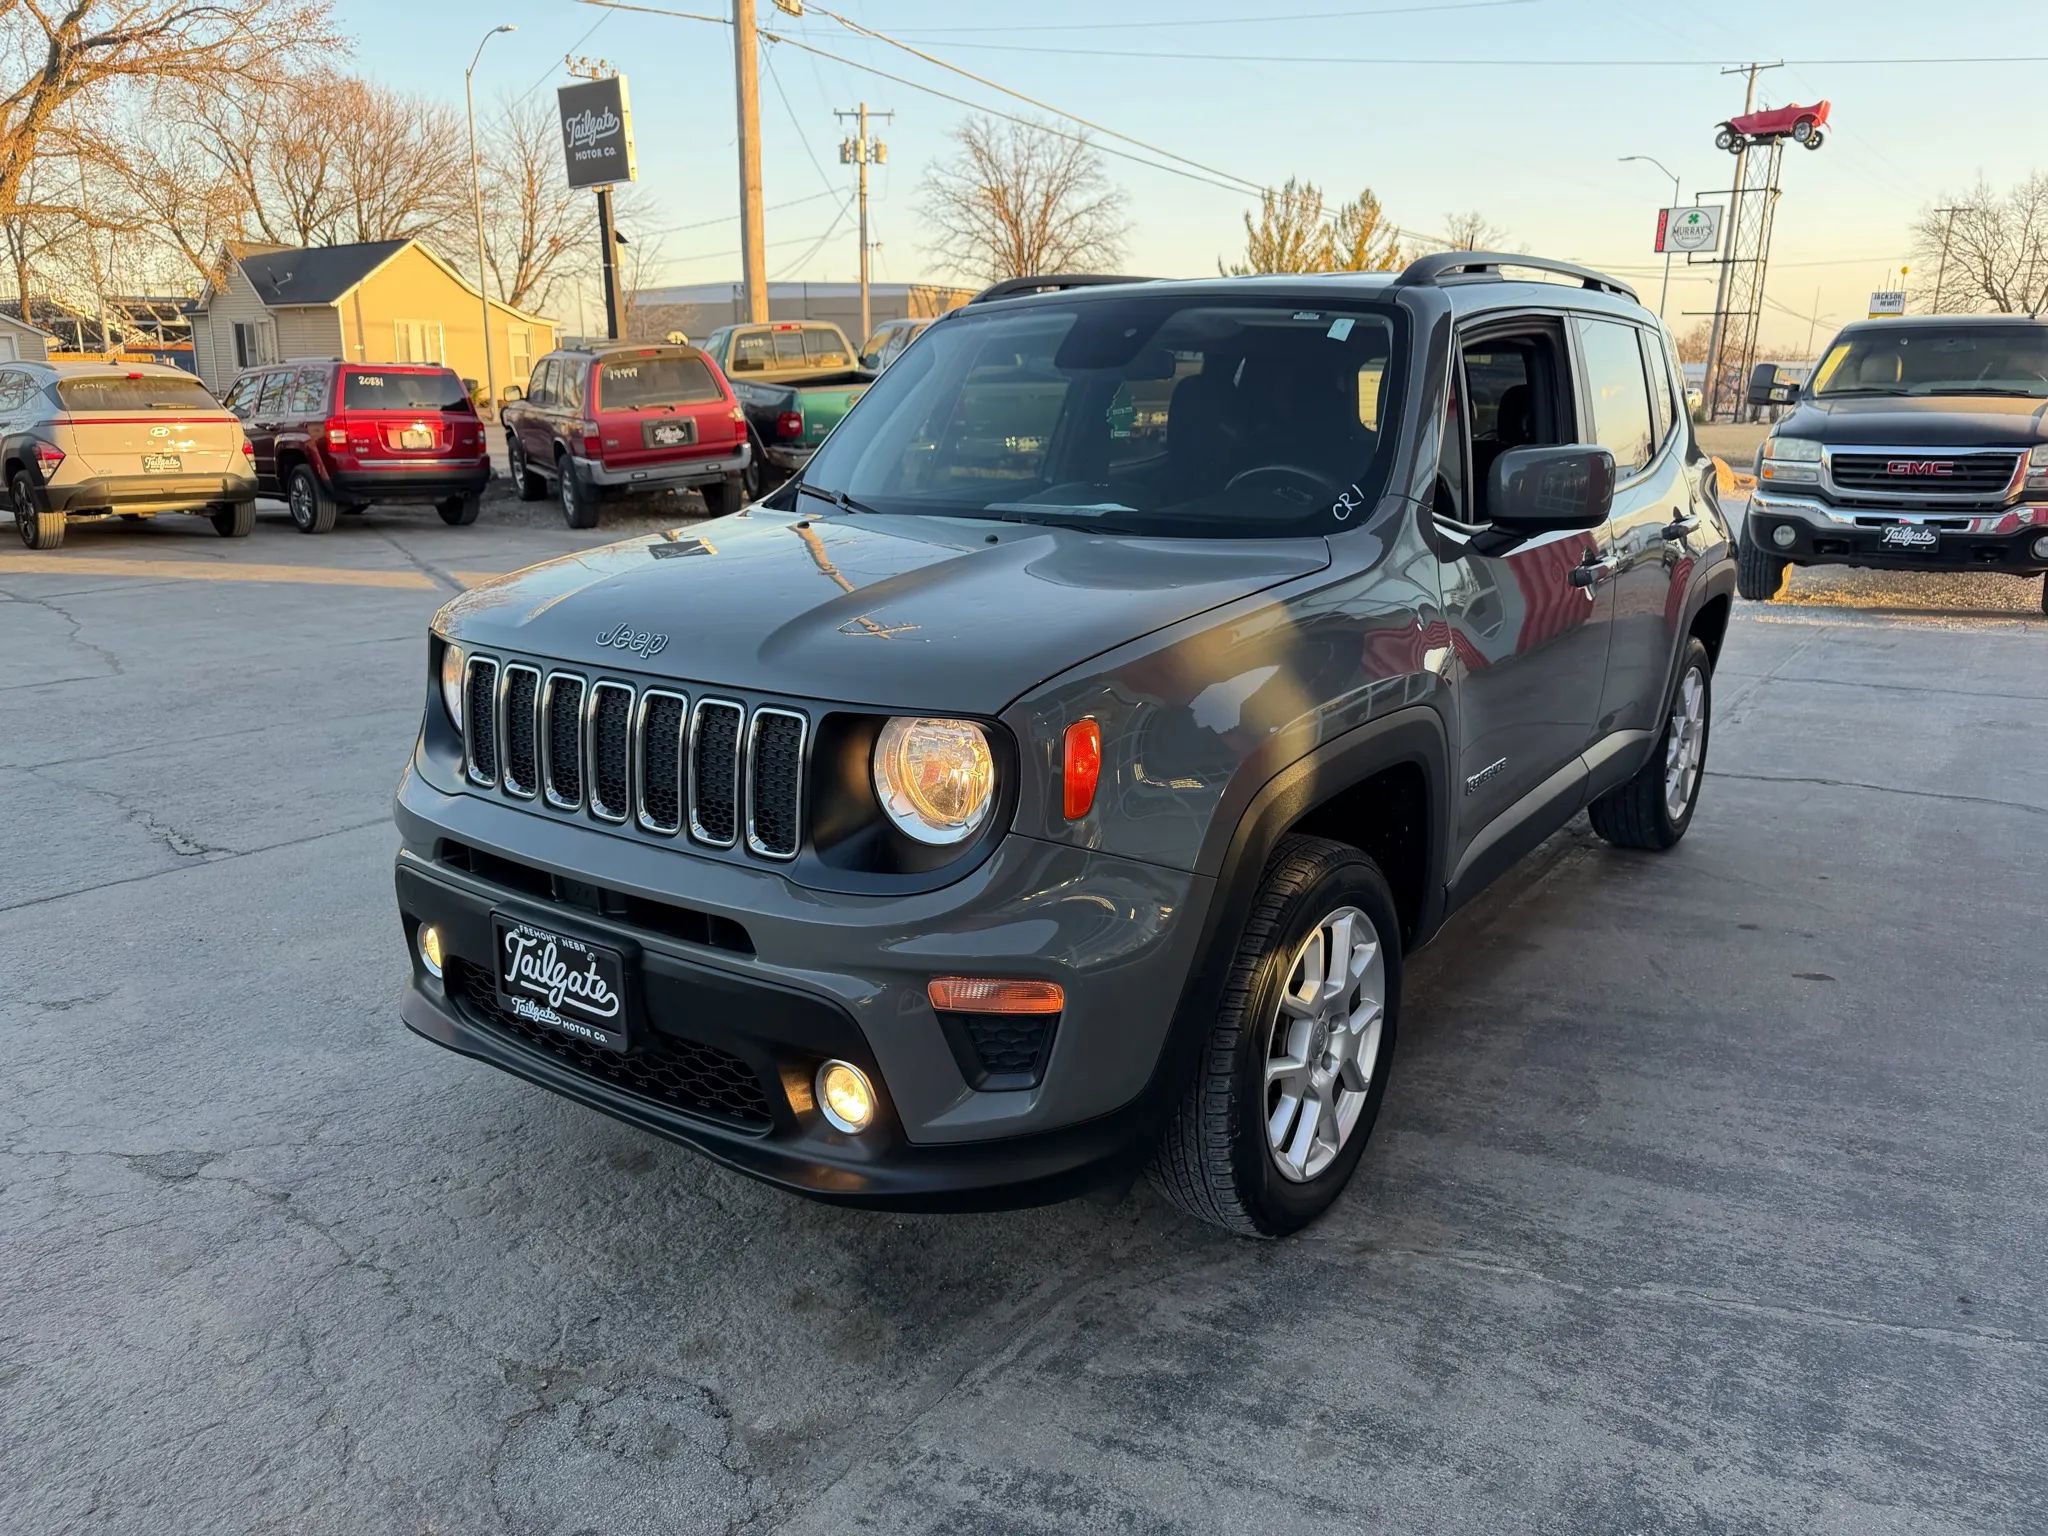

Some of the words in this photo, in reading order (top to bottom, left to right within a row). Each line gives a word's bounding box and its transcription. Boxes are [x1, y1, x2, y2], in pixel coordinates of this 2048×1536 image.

[566, 106, 620, 148] Tailgate
[576, 149, 602, 160] MOTOR
[604, 147, 616, 156] CO.
[1874, 292, 1903, 300] JACKSON
[1887, 460, 1954, 476] GMC
[1882, 526, 1937, 546] Tailgate
[595, 622, 670, 660] Jeep
[519, 924, 557, 945] FREMONT
[561, 938, 587, 953] NEBR
[504, 931, 620, 1018] Tailgate
[511, 997, 562, 1025] Tailgate
[562, 1020, 592, 1038] MOTOR
[593, 1030, 608, 1043] CO.
